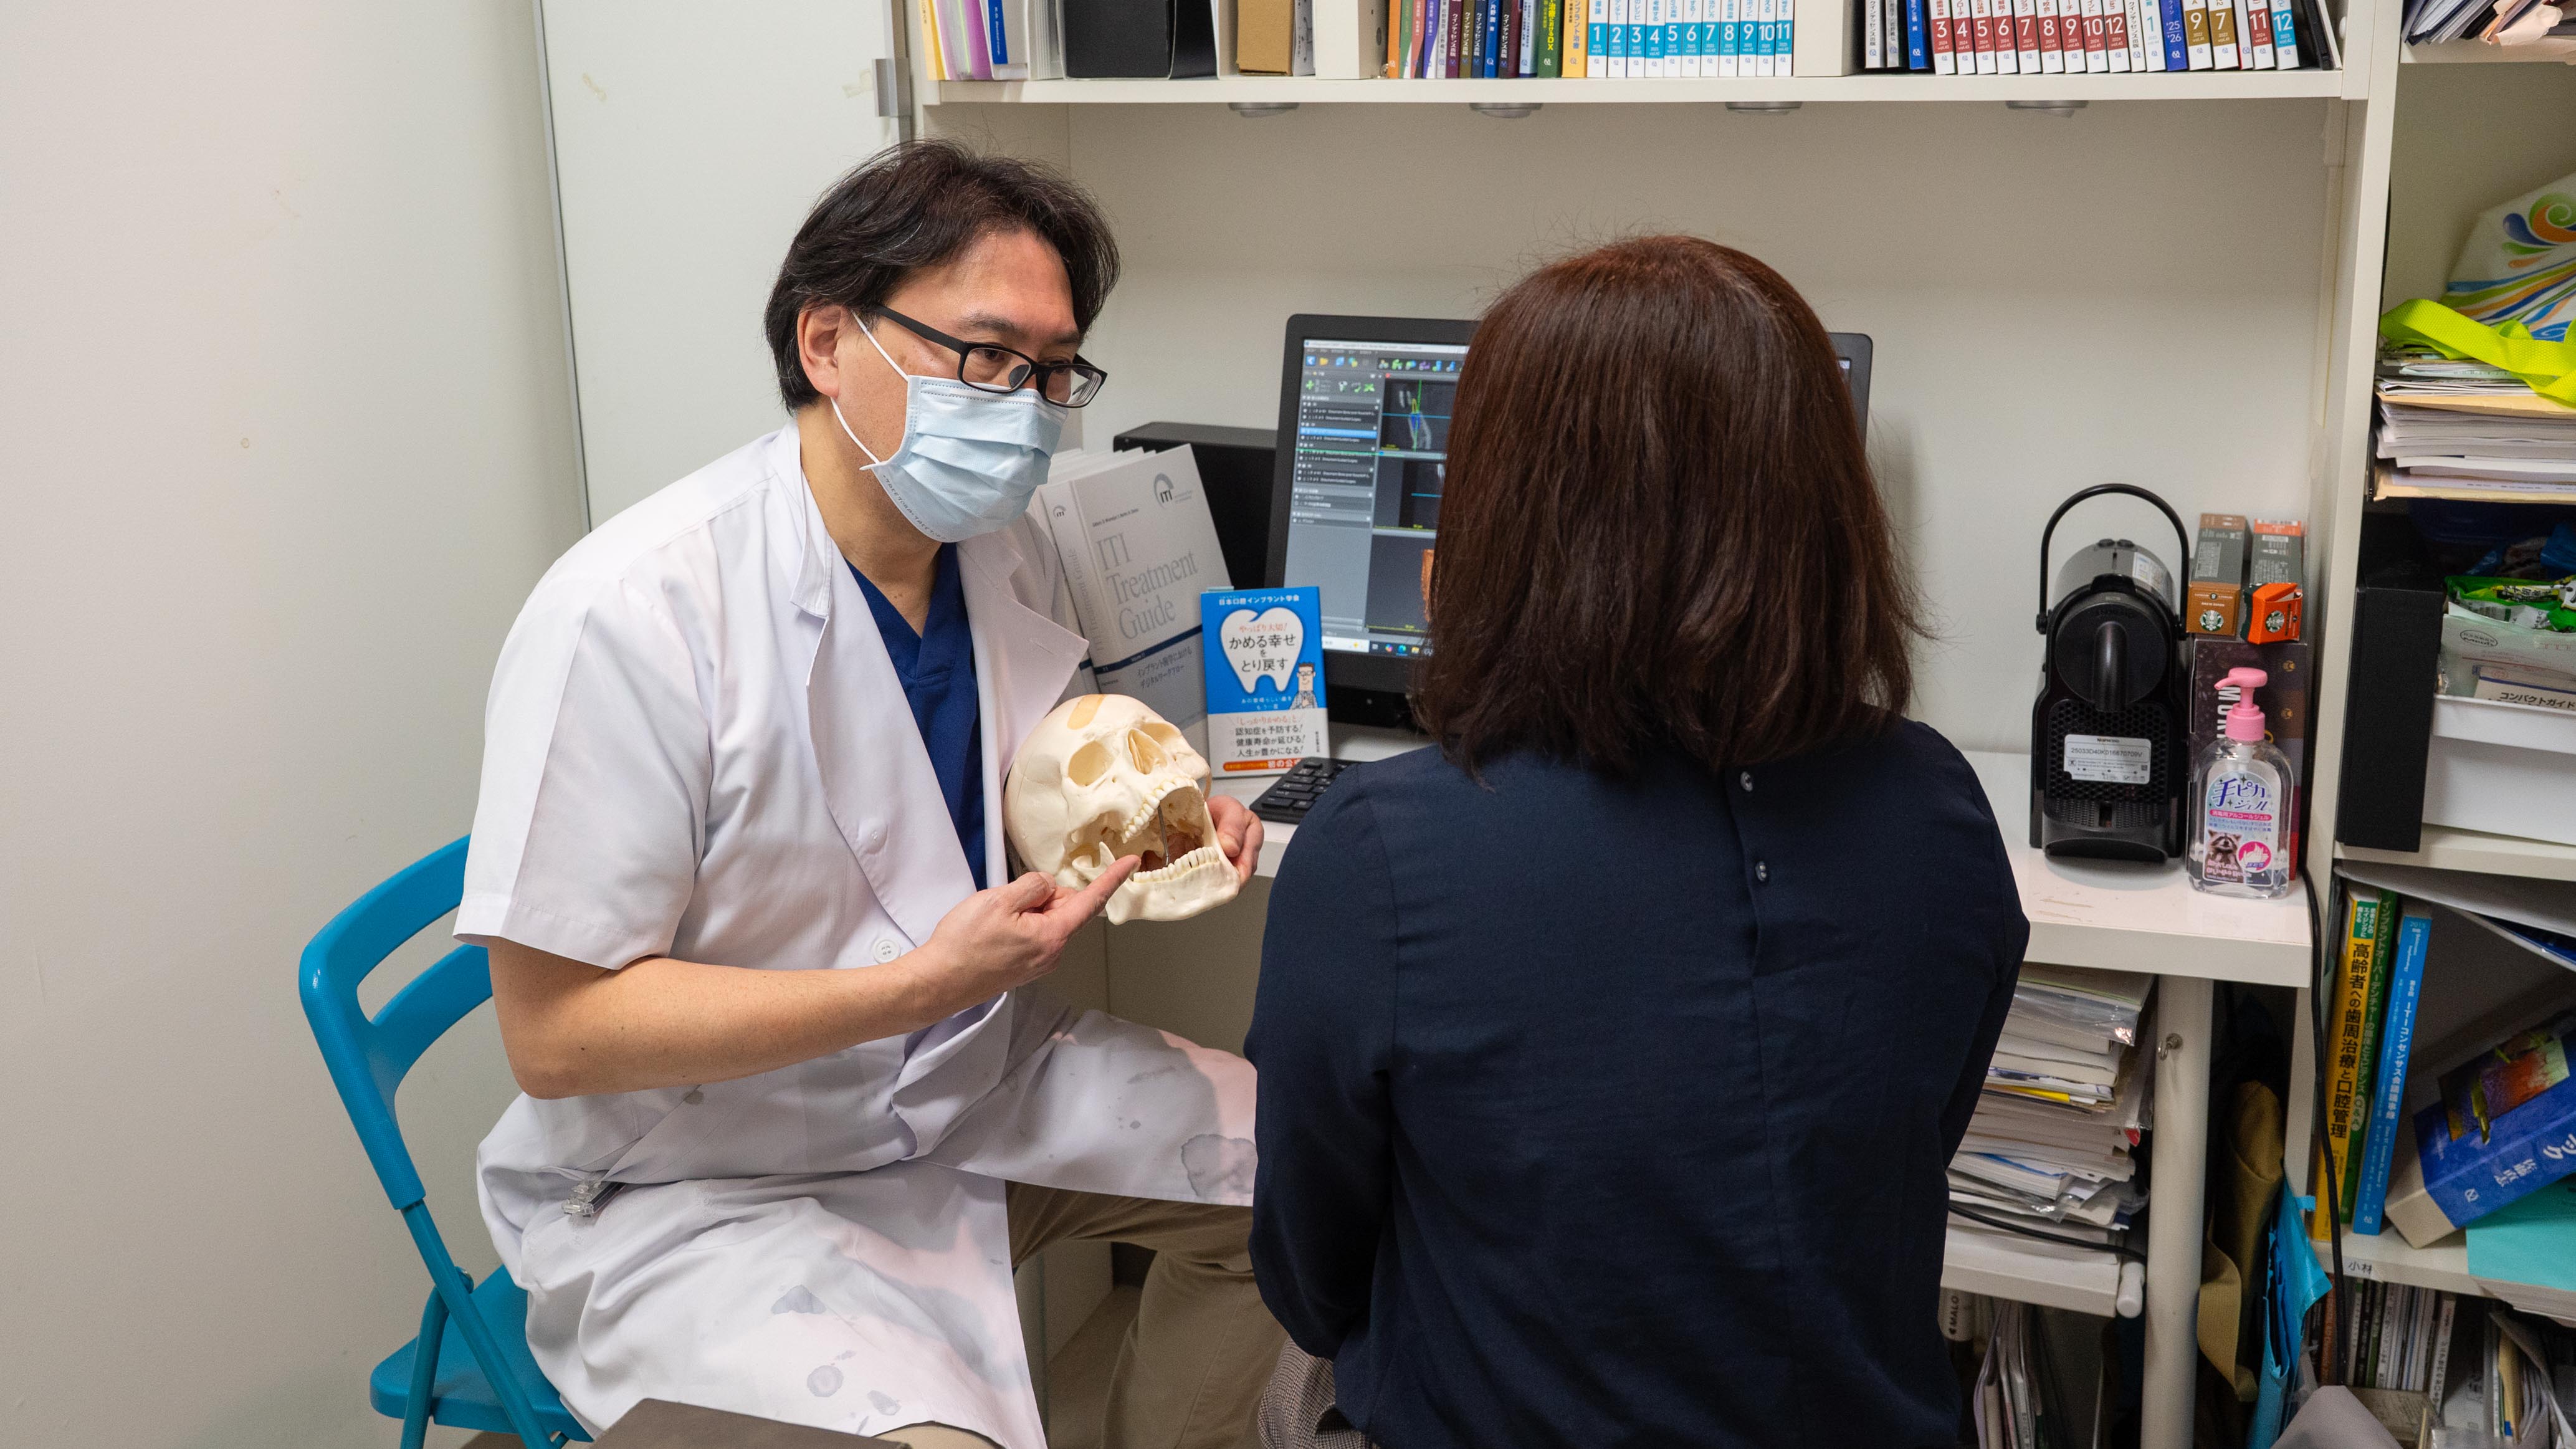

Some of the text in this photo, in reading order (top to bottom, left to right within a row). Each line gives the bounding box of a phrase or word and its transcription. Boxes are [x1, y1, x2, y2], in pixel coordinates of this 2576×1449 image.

[1977, 20, 1988, 37] 5
[1998, 19, 2010, 36] 6
[2020, 19, 2030, 36] 7
[2043, 19, 2054, 36] 8
[2066, 18, 2077, 36] 9
[2083, 18, 2103, 36] 10
[2106, 17, 2124, 34] 12
[2129, 2, 2139, 48] クインテッセンス出版
[2147, 16, 2154, 32] 1
[2166, 21, 2180, 30] '25
[2190, 12, 2202, 29] 9
[2216, 12, 2226, 30] 7
[2249, 12, 2266, 30] 11
[2274, 13, 2292, 31] 12
[1449, 13, 1458, 57] クインテッセンス出版
[1462, 12, 1471, 55] クインテッセンス出版
[1474, 12, 1482, 56] クインテッセンス出版
[1500, 14, 1509, 58] クインテッセンス出版
[1594, 26, 1600, 41] 1
[1612, 27, 1621, 42] 2
[1631, 27, 1641, 42] 3
[1650, 29, 1659, 44] 4
[1667, 26, 1677, 41] 5
[1687, 25, 1697, 41] 6
[1706, 25, 1715, 41] 7
[1724, 25, 1734, 41] 8
[1744, 24, 1753, 40] 9
[1758, 25, 1775, 41] 10
[1777, 23, 1790, 39] 11
[1936, 21, 1947, 37] 3
[1957, 21, 1968, 37] 4
[2167, 34, 2181, 42] '26
[1160, 489, 1173, 504] ITI
[1056, 510, 1065, 518] ITI
[1095, 532, 1132, 571] ITI
[1105, 550, 1199, 606] Treatment
[1118, 595, 1178, 639] Guide
[1229, 634, 1296, 649] かめる幸せ
[1241, 658, 1288, 672] とり戻す
[2212, 778, 2266, 807] 手ピカ
[2235, 800, 2268, 810] ジェル
[2330, 943, 2370, 1139] 高齢者への歯周治療と口腔管理
